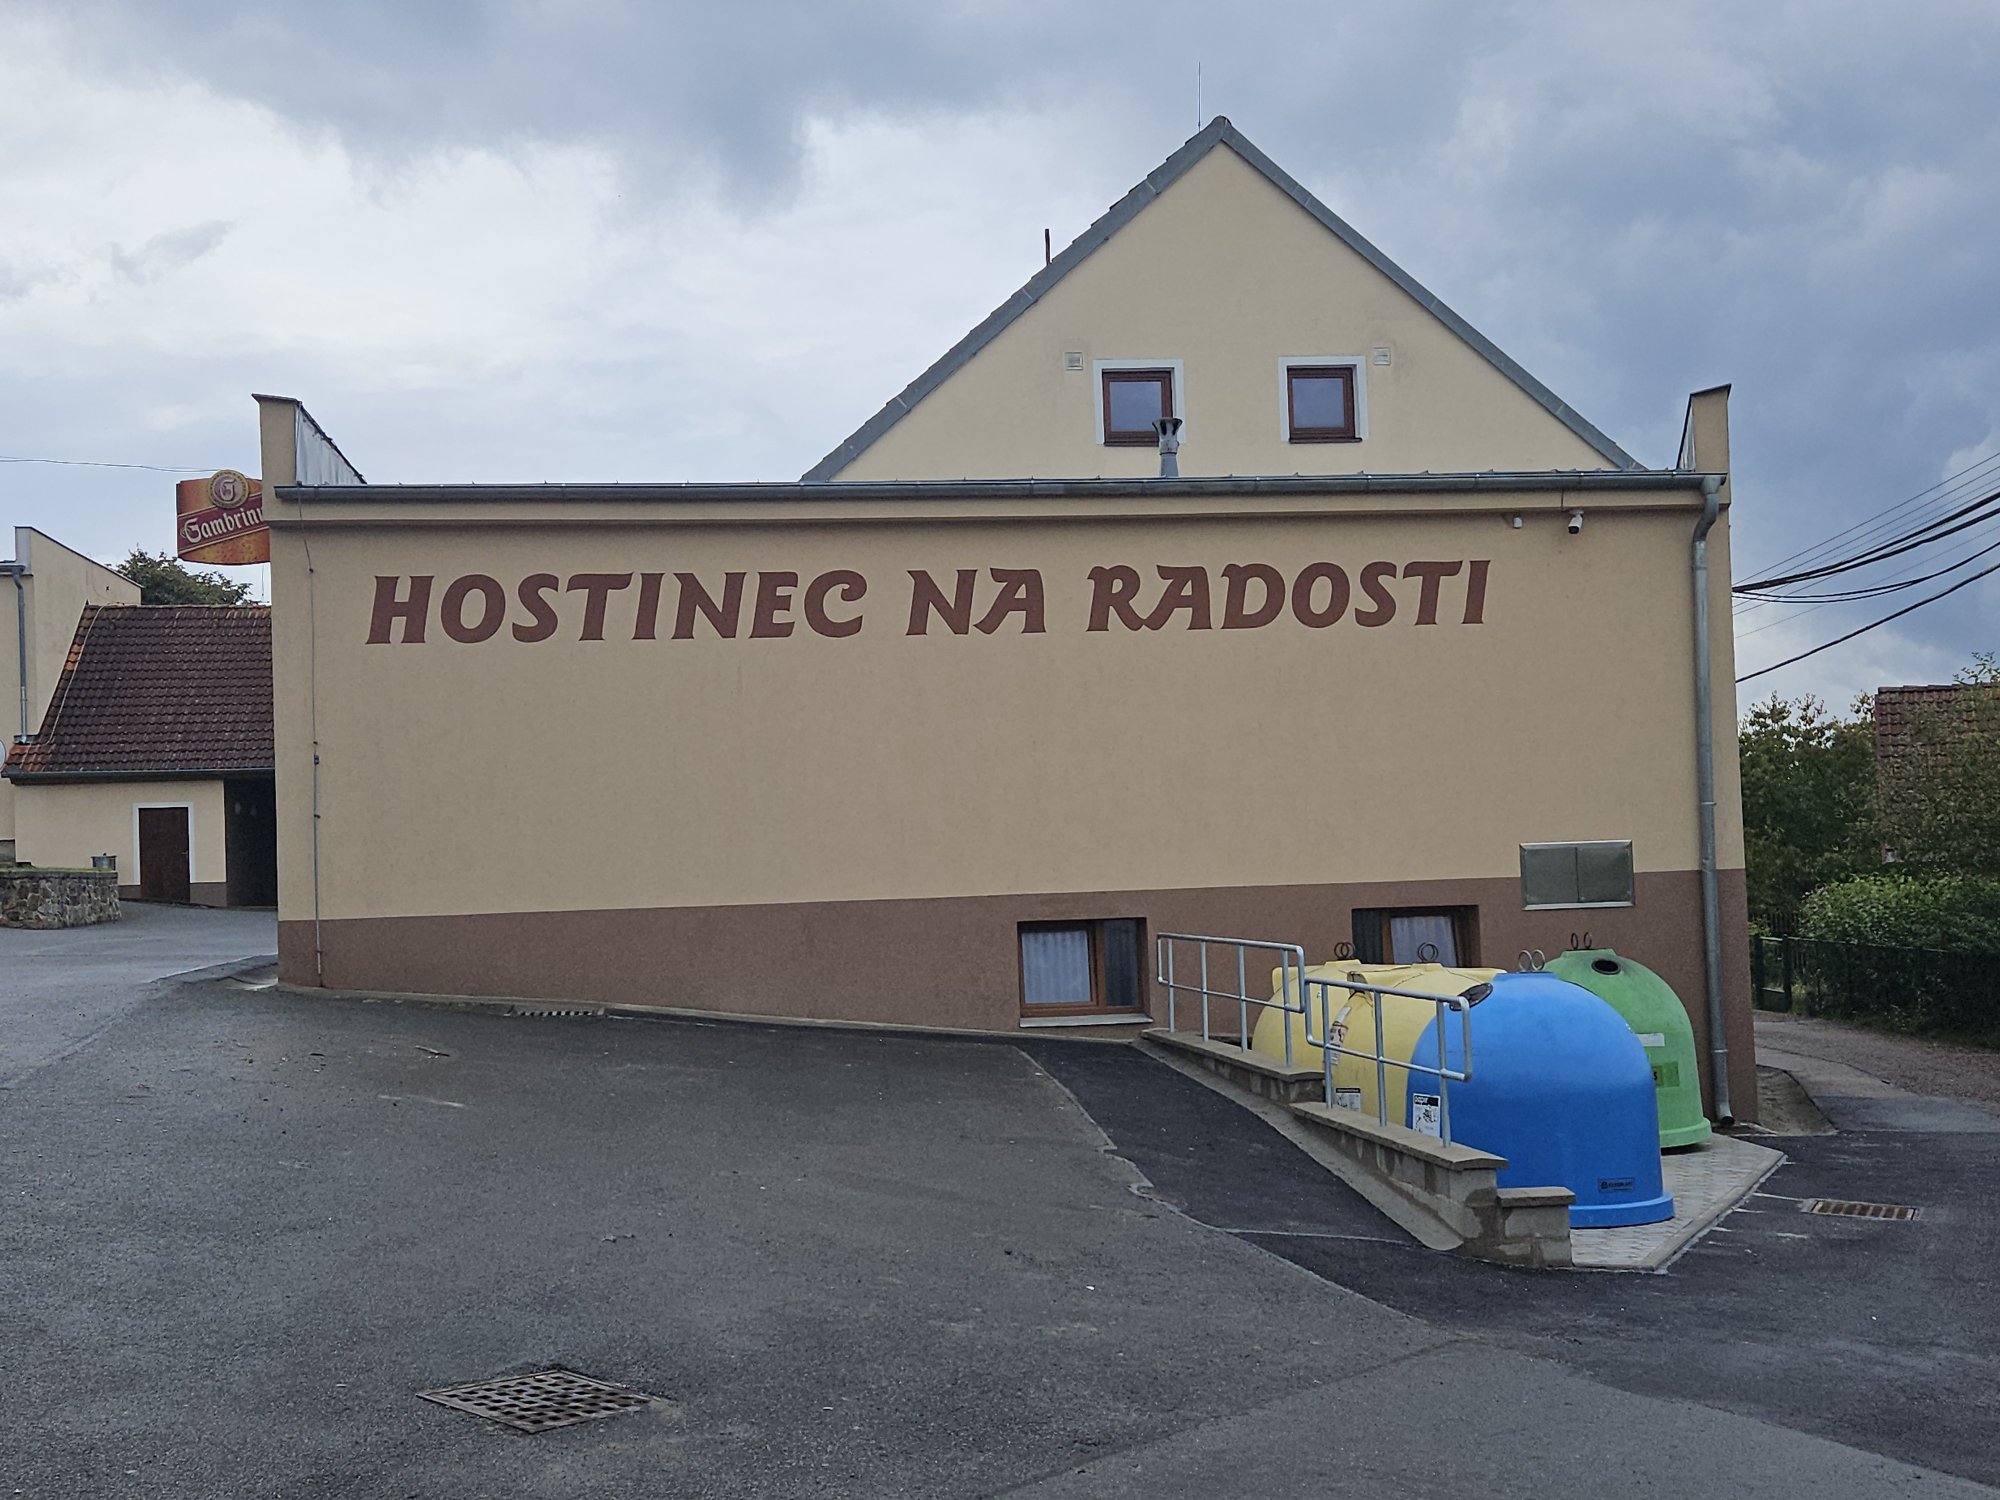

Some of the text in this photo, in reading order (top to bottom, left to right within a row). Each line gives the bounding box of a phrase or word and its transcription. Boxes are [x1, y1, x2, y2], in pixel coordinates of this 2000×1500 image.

[181, 507, 263, 543] Gambrin
[366, 560, 1492, 645] HOSTINEC NA RADOSTI
